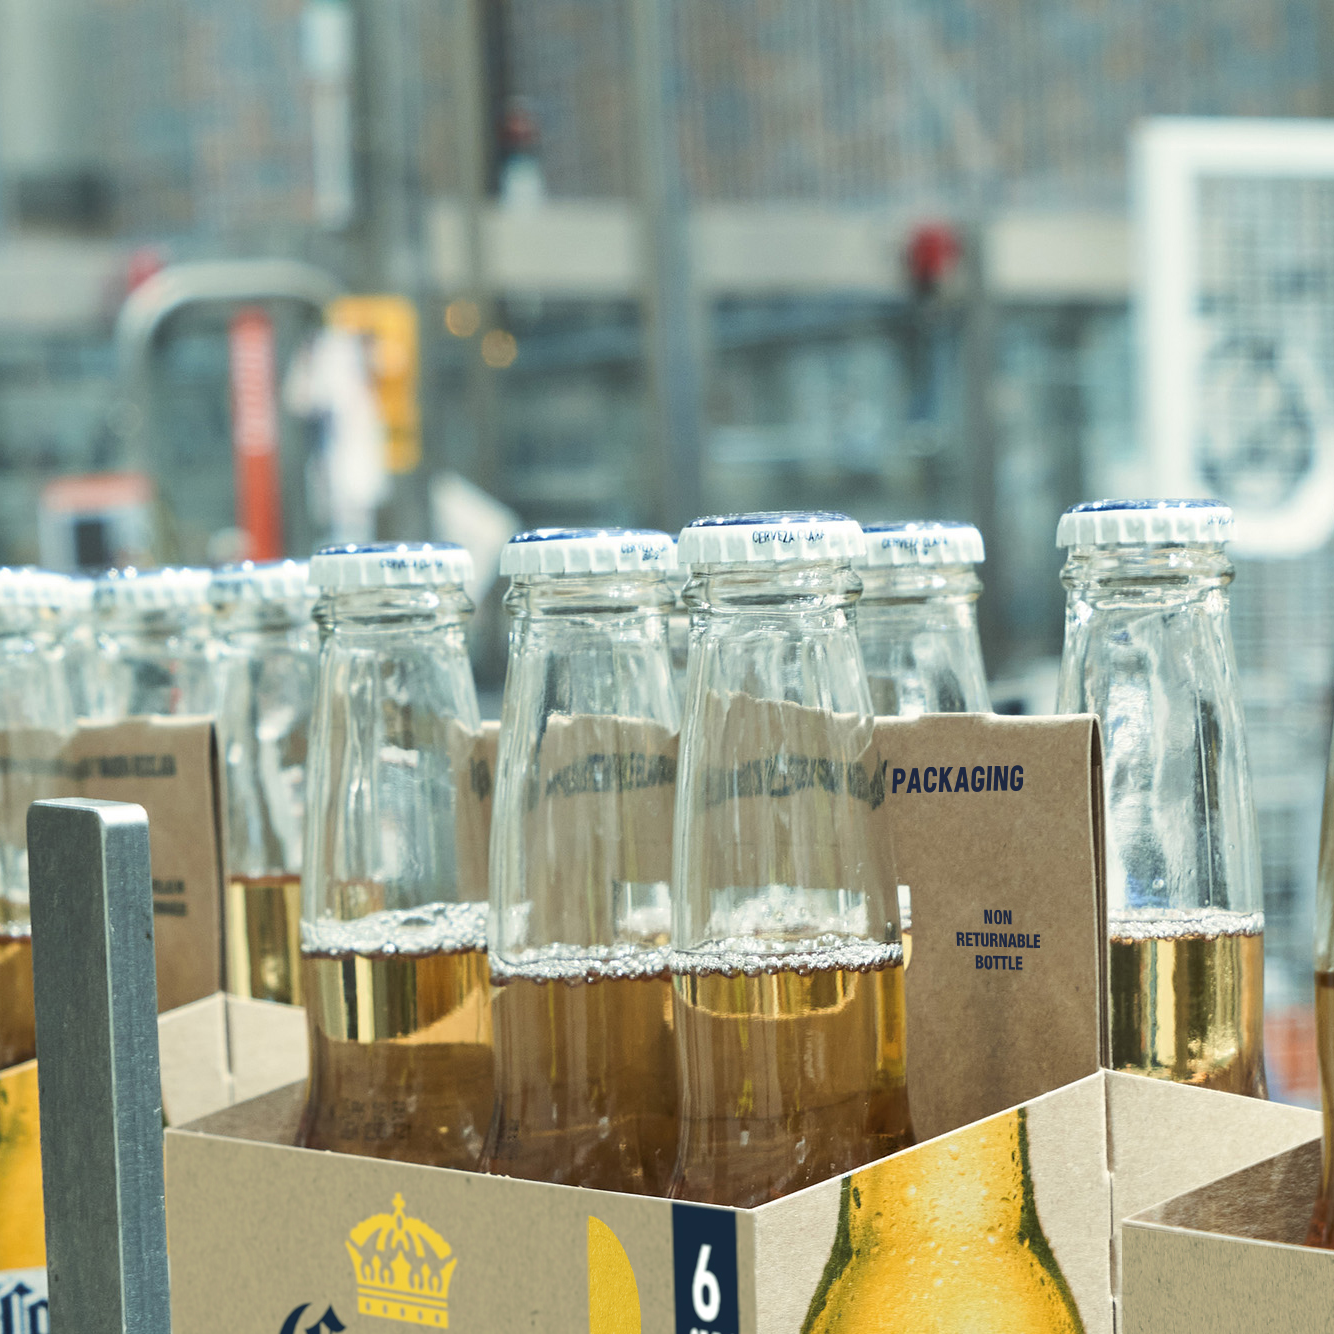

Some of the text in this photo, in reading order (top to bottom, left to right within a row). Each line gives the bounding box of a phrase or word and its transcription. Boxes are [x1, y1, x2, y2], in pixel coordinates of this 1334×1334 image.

[891, 764, 1025, 795] PACKAGING
[983, 909, 1013, 926] NON
[956, 931, 1042, 950] RETURNABLE
[975, 954, 1024, 972] BOTTLE
[691, 1243, 721, 1323] 6
